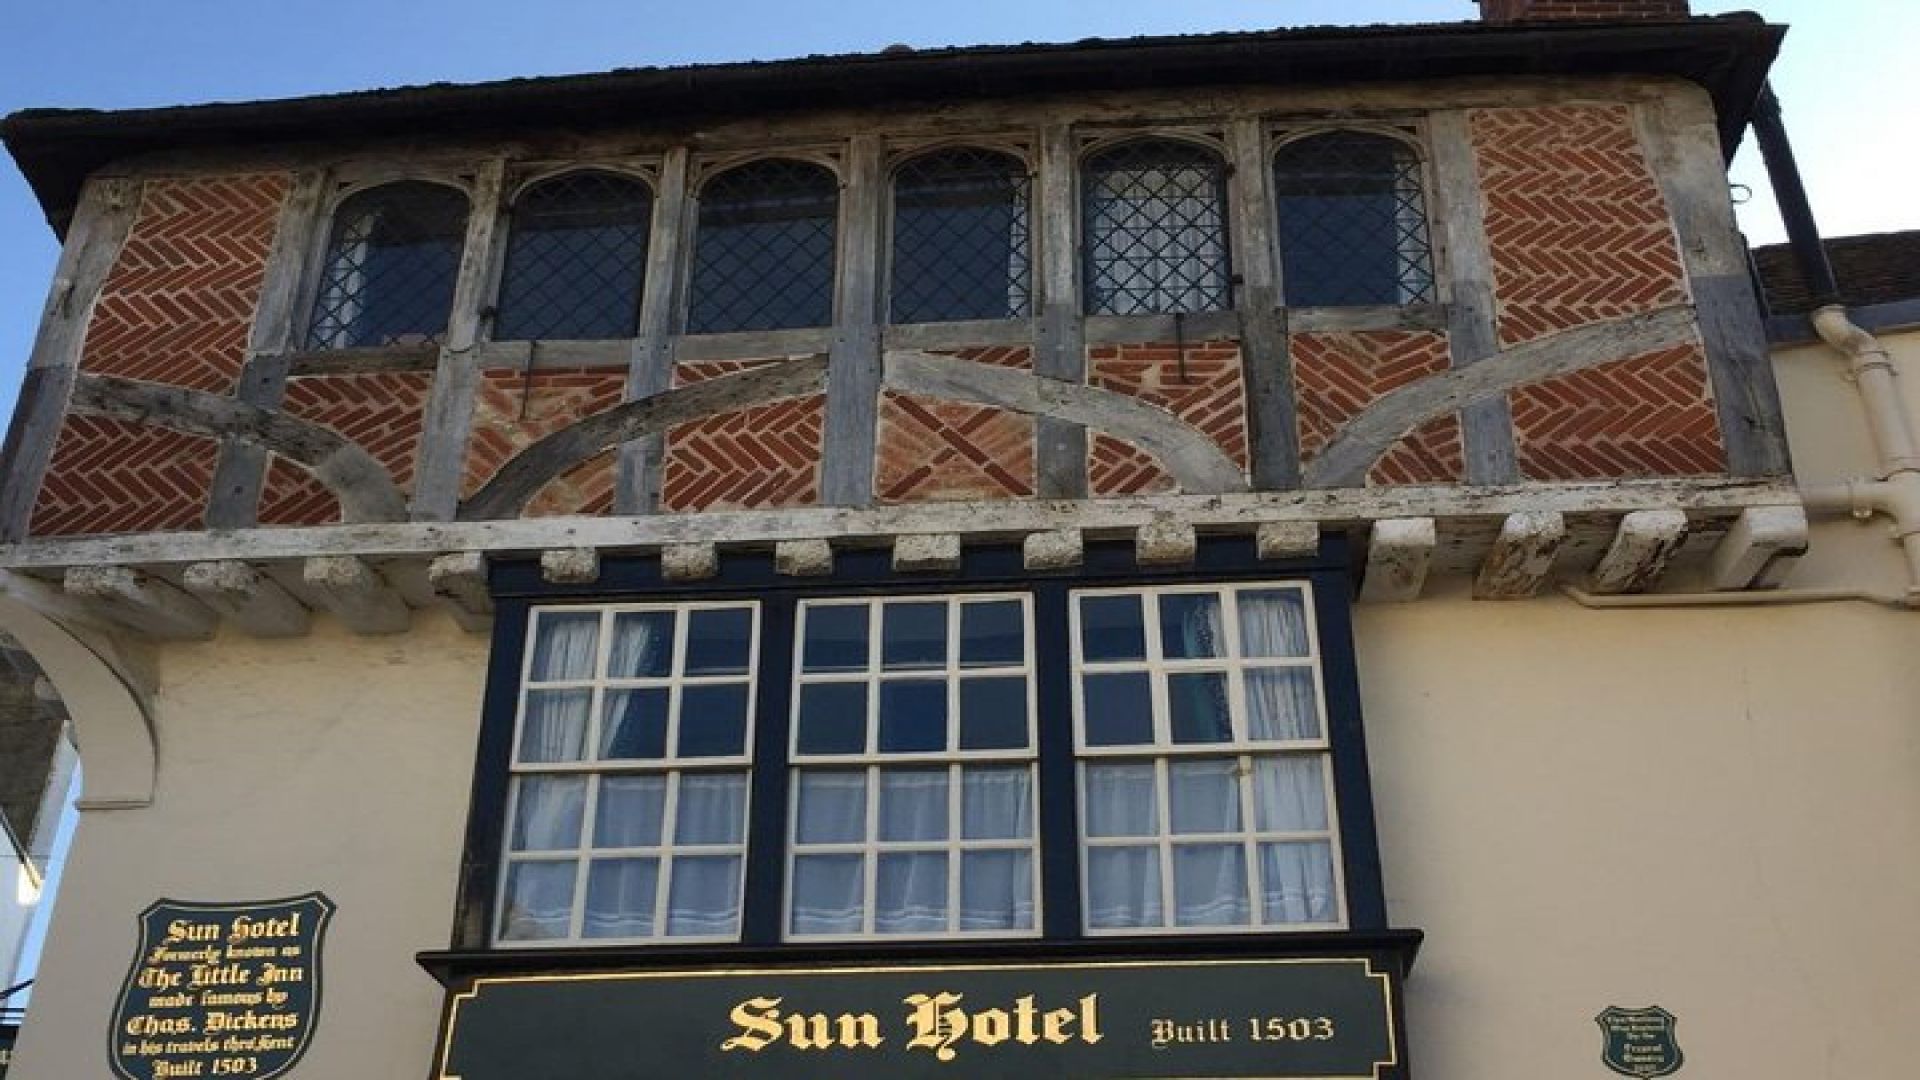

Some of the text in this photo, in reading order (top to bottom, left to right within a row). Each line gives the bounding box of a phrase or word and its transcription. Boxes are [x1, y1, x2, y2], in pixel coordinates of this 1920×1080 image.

[162, 911, 301, 945] Sun Hotel
[138, 966, 183, 992] The
[187, 963, 250, 990] Little
[149, 987, 288, 1010] made famous by
[203, 1009, 299, 1034] Dickens
[720, 991, 1104, 1062] Sun Hotel
[1151, 1016, 1336, 1050] Built 1503
[152, 1057, 257, 1080] Built 1503
